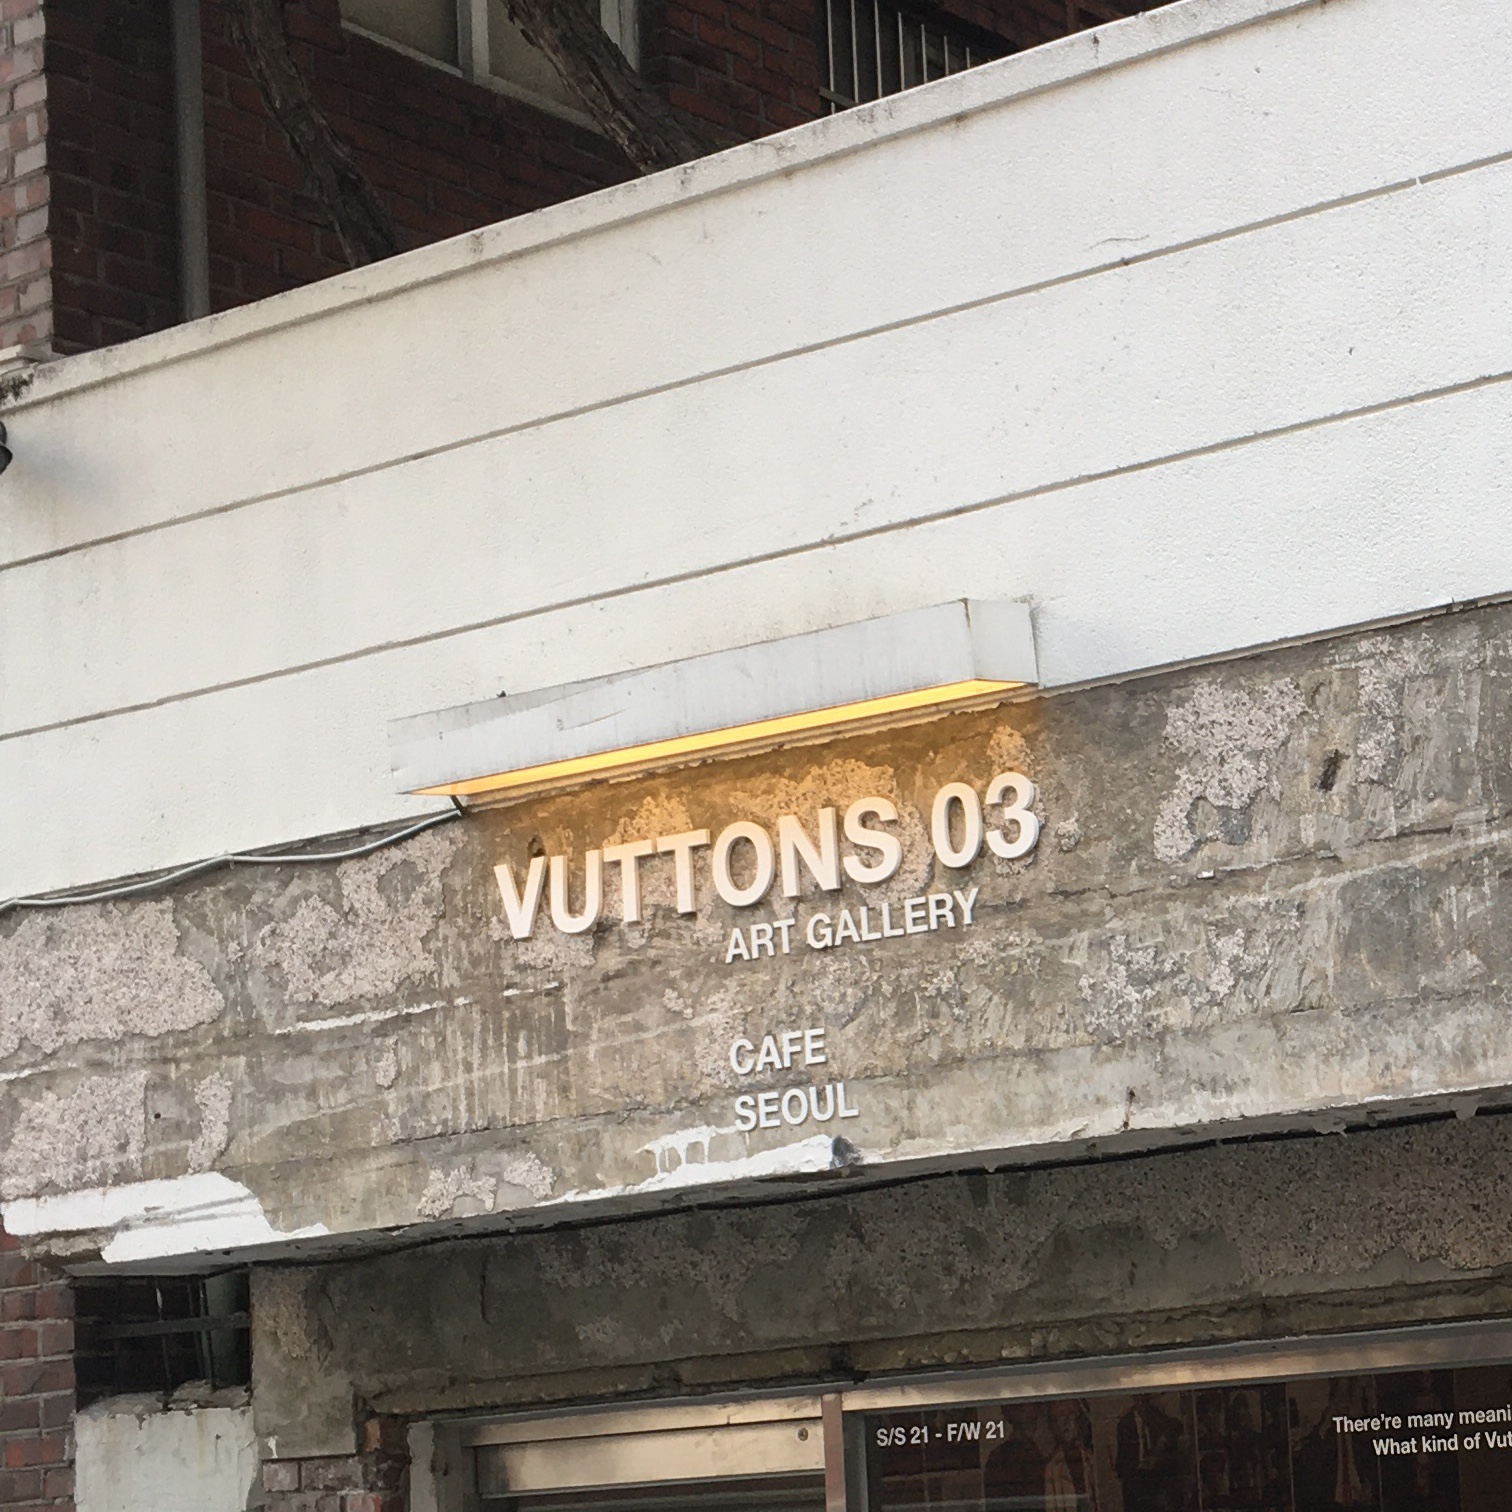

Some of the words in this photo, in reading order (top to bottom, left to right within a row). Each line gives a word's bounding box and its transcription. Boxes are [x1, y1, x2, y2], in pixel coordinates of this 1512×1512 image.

[494, 796, 903, 940] VUTTONS
[931, 771, 1040, 869] 03
[725, 918, 795, 963] ART
[807, 887, 980, 950] GALLERY
[730, 1028, 827, 1075] CAFE
[734, 1082, 859, 1132] SEOUL
[876, 1427, 906, 1447] S/S
[910, 1426, 928, 1443] 21
[947, 1422, 981, 1442] F/W
[985, 1420, 1004, 1439] 21
[1332, 1413, 1401, 1434] There're
[1407, 1411, 1454, 1430] many
[1373, 1438, 1417, 1456] What
[1422, 1433, 1458, 1453] kind
[1463, 1432, 1481, 1449] of
